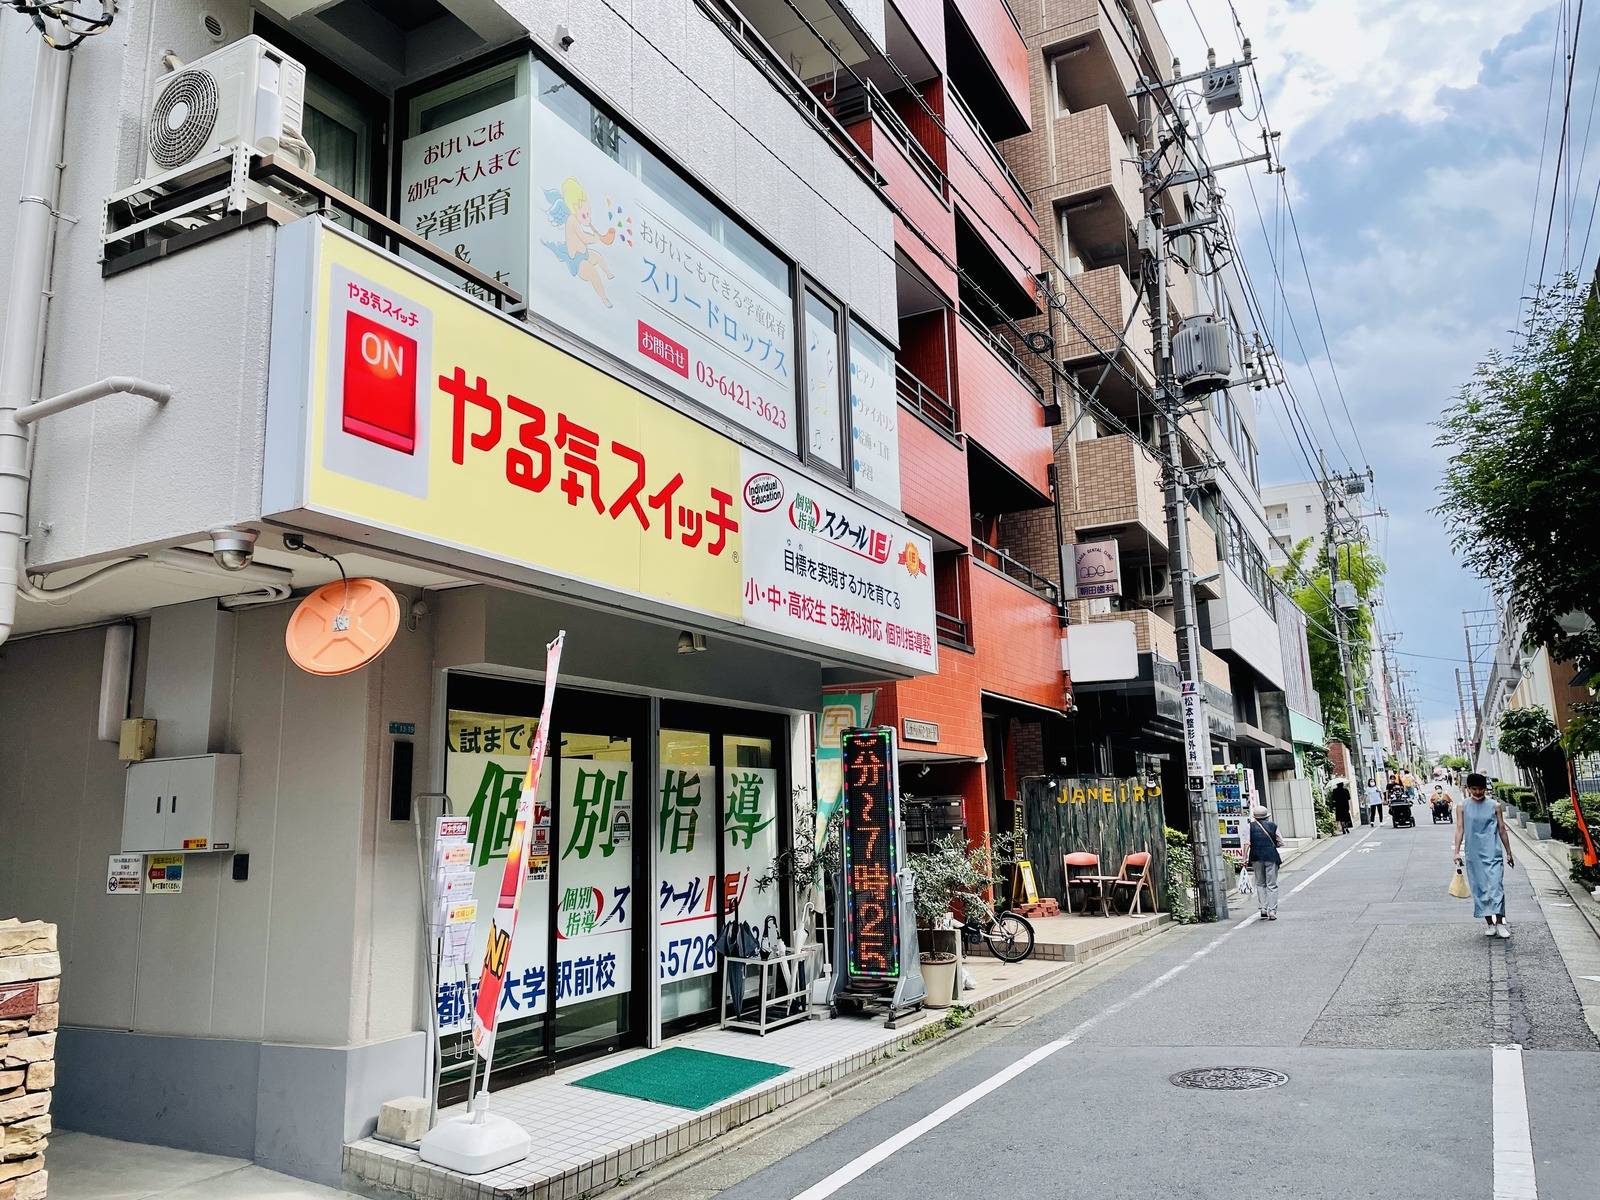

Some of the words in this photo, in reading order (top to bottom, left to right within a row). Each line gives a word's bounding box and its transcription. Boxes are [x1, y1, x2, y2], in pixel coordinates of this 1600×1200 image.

[423, 120, 505, 165] おけいこは
[416, 187, 511, 240] 学童保育
[454, 243, 472, 265] &
[640, 219, 786, 341] おけいこもできる学童保育
[347, 281, 419, 327] やる気スイッチ
[641, 257, 788, 377] スリードロップス
[361, 331, 404, 377] ON
[641, 330, 685, 369] お問合せ
[696, 360, 788, 430] 03-6421-3623
[438, 365, 740, 557] やる気スイッチ
[748, 478, 778, 496] Individual
[750, 490, 782, 506] Education
[794, 492, 814, 514] 個別
[798, 512, 818, 534] 指導
[1087, 547, 1102, 555] DENTAL
[784, 548, 901, 610] 目標を実現する力を育てる
[745, 577, 827, 626] 小・中・高校生
[830, 604, 882, 642] 5教科対応
[885, 622, 933, 656] 個別指導塾
[1184, 696, 1197, 762] 松本整形外科
[562, 886, 592, 912] 個別
[565, 910, 598, 937] 指導
